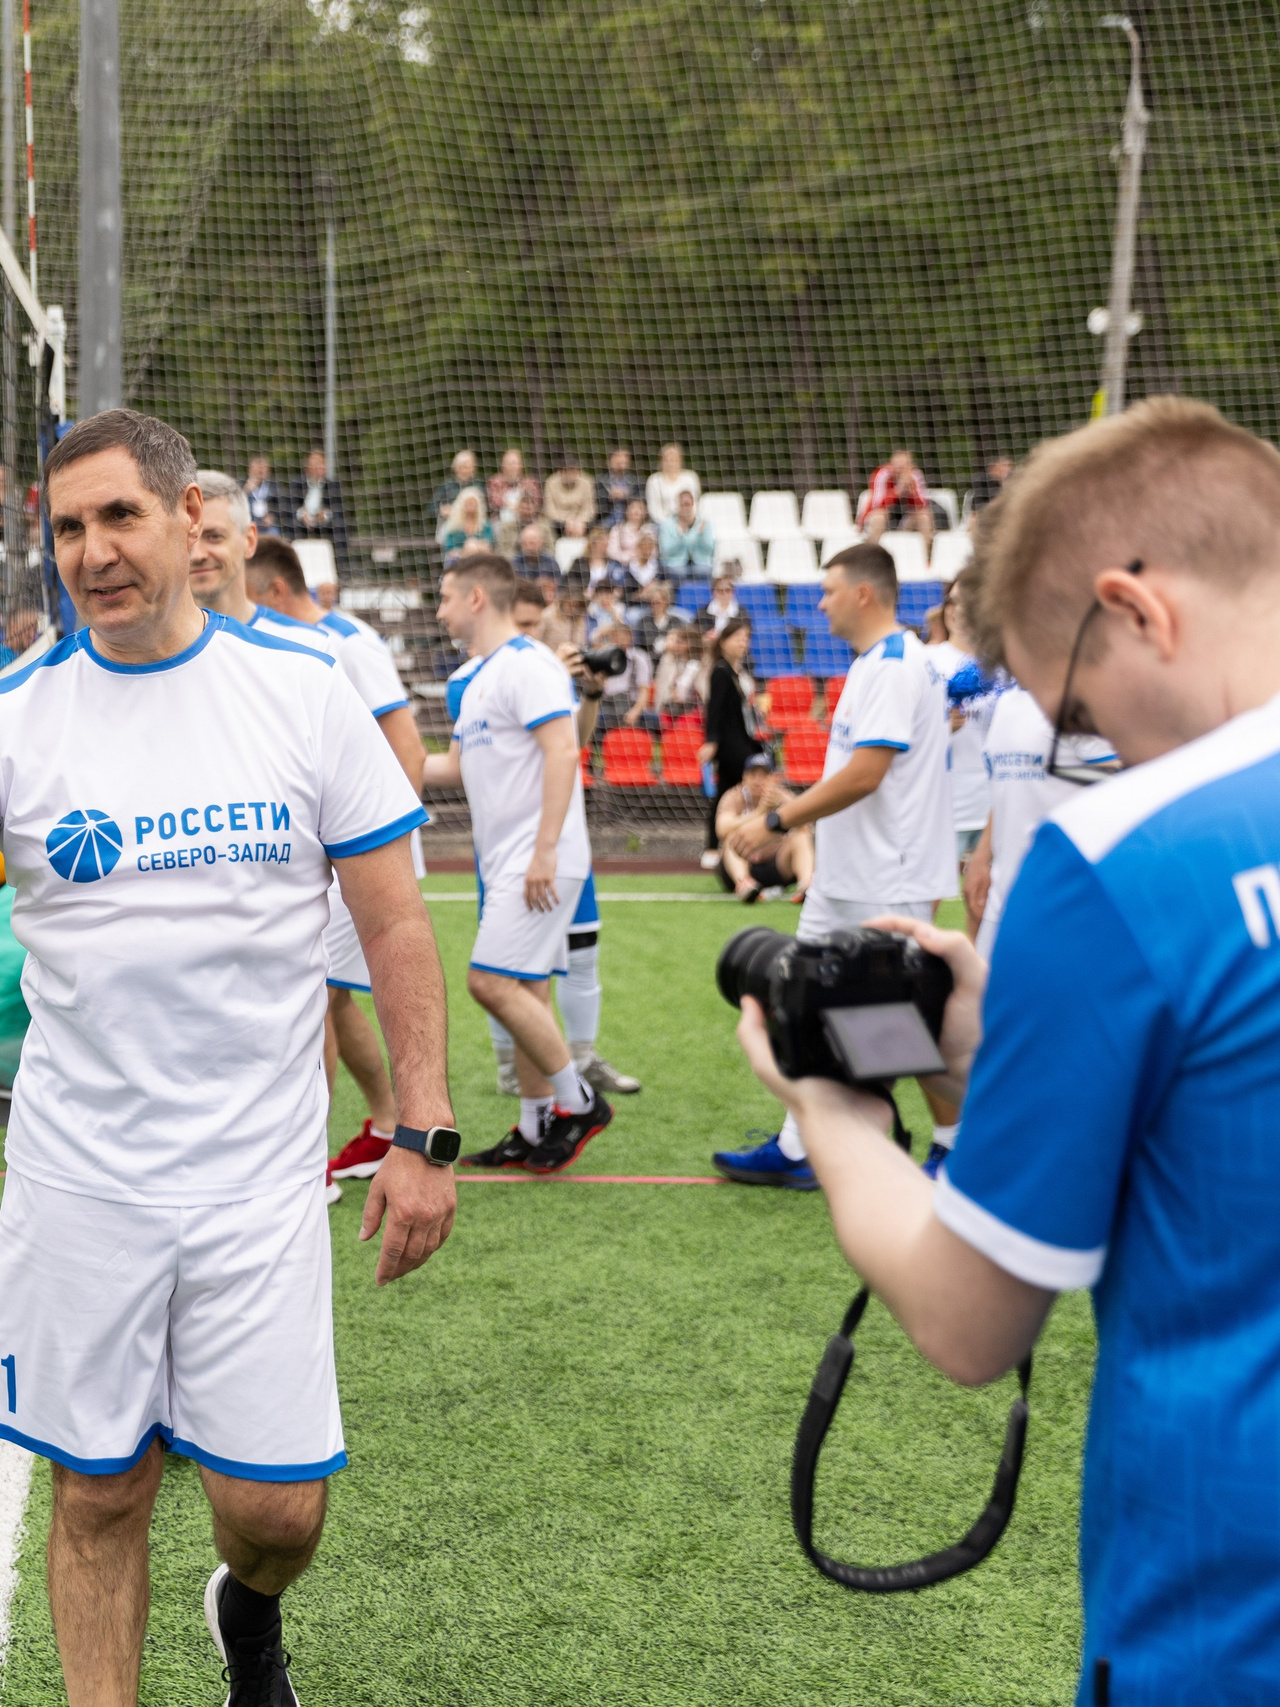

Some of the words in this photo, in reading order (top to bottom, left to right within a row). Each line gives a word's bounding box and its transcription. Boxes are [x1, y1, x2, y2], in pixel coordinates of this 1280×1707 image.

[135, 801, 291, 844] РОССЕТИ
[137, 843, 292, 872] СЕВЕРО-ЗАПАД
[1, 1354, 17, 1414] 1
